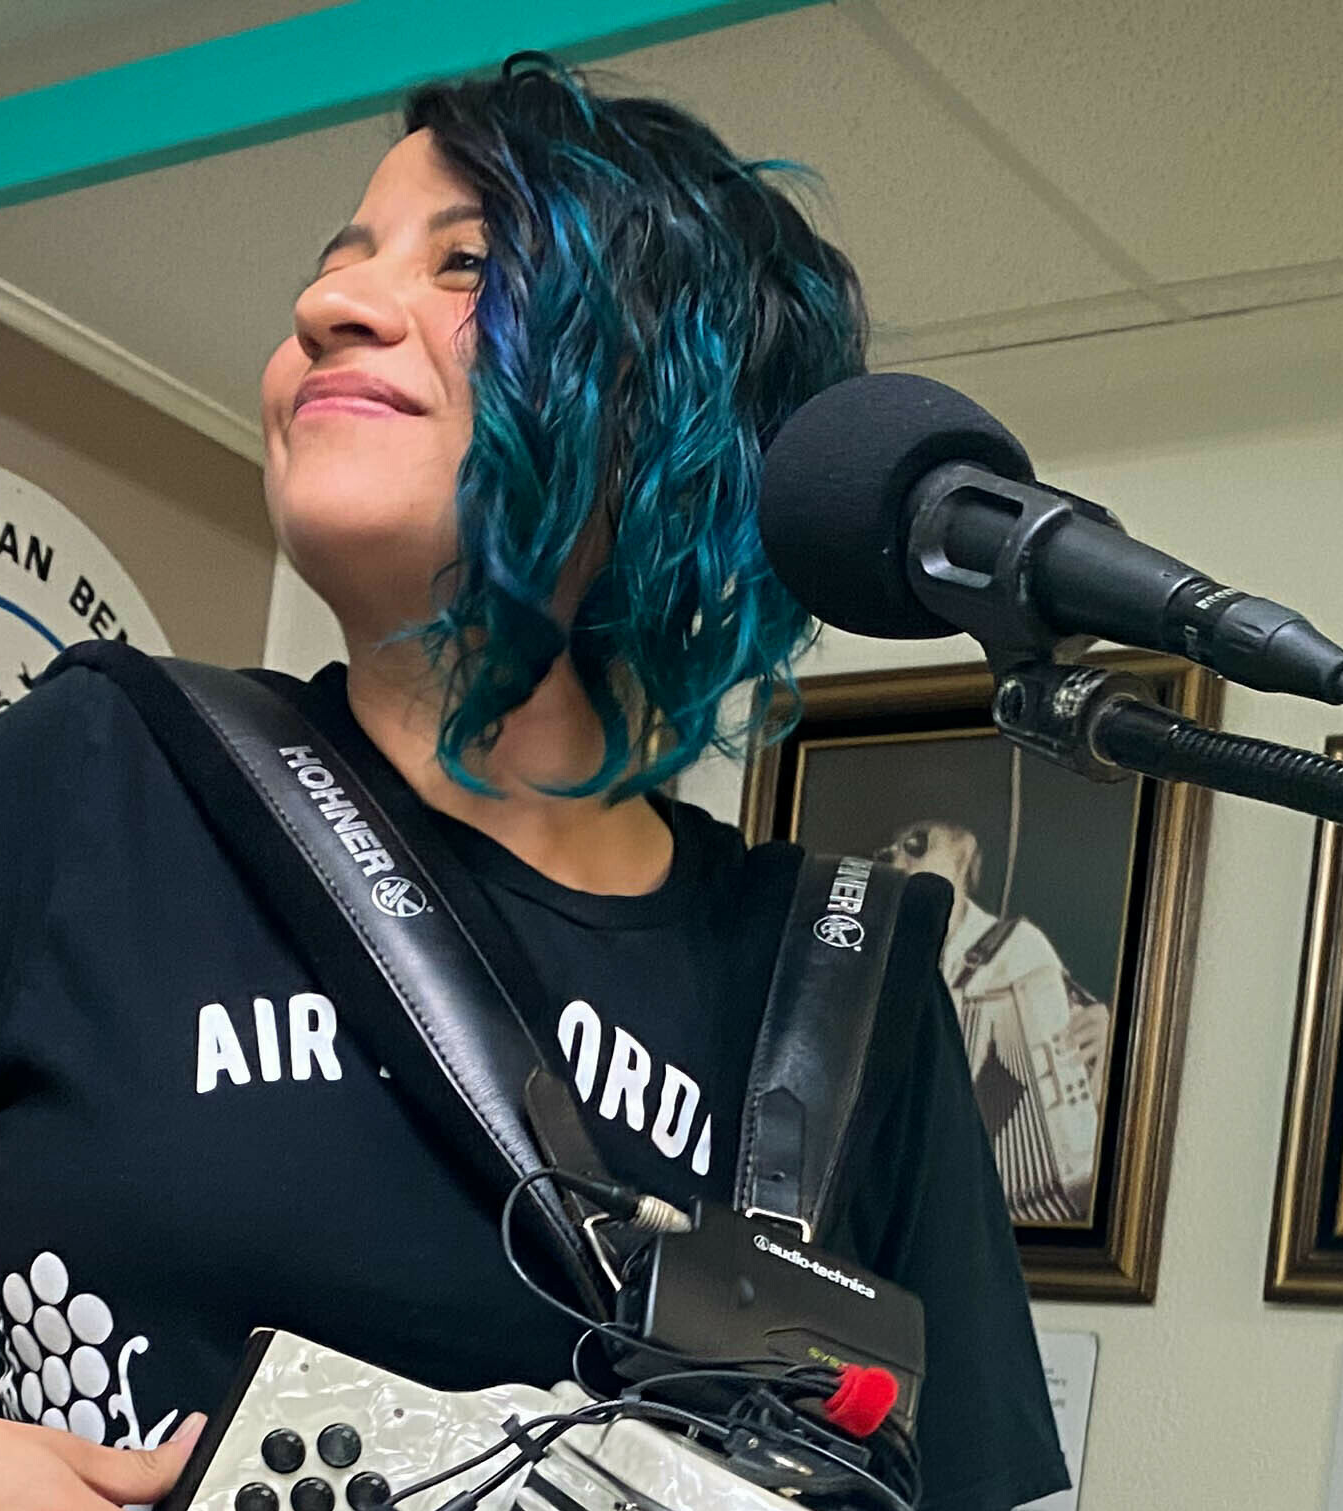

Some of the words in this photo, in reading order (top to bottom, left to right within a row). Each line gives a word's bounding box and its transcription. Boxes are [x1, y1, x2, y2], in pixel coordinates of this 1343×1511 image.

[278, 744, 396, 878] HOHNER
[196, 992, 343, 1094] AIR
[768, 1243, 876, 1299] audio-technica
